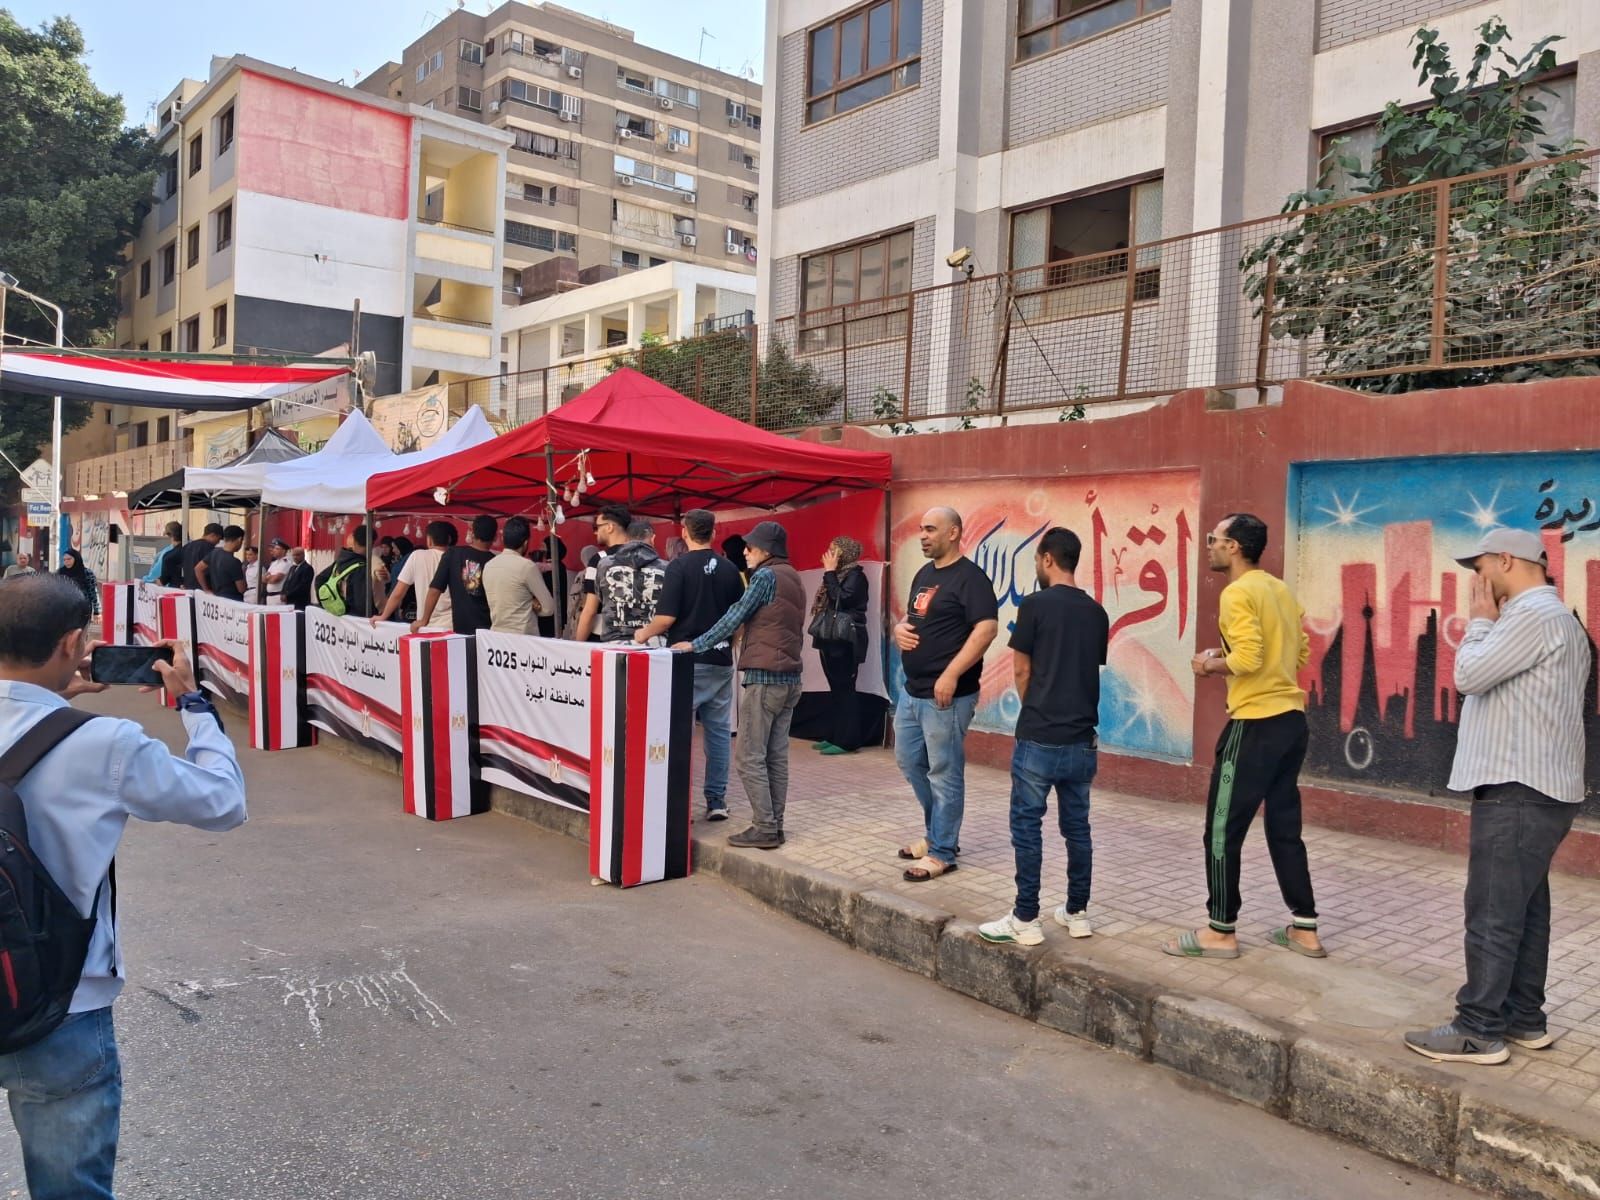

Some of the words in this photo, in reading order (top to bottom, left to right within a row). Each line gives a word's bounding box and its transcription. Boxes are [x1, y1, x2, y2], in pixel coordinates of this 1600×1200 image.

[203, 601, 218, 620] 2025
[315, 621, 336, 646] 2025
[338, 630, 358, 650] النواب
[361, 633, 385, 656] مجلس
[344, 657, 360, 676] الجيزة
[487, 648, 517, 670] 2025
[520, 653, 547, 672] النواب
[550, 659, 582, 679] مجلس
[361, 661, 386, 680] محافظة
[525, 684, 547, 703] الجيزة
[549, 687, 585, 708] محافظة
